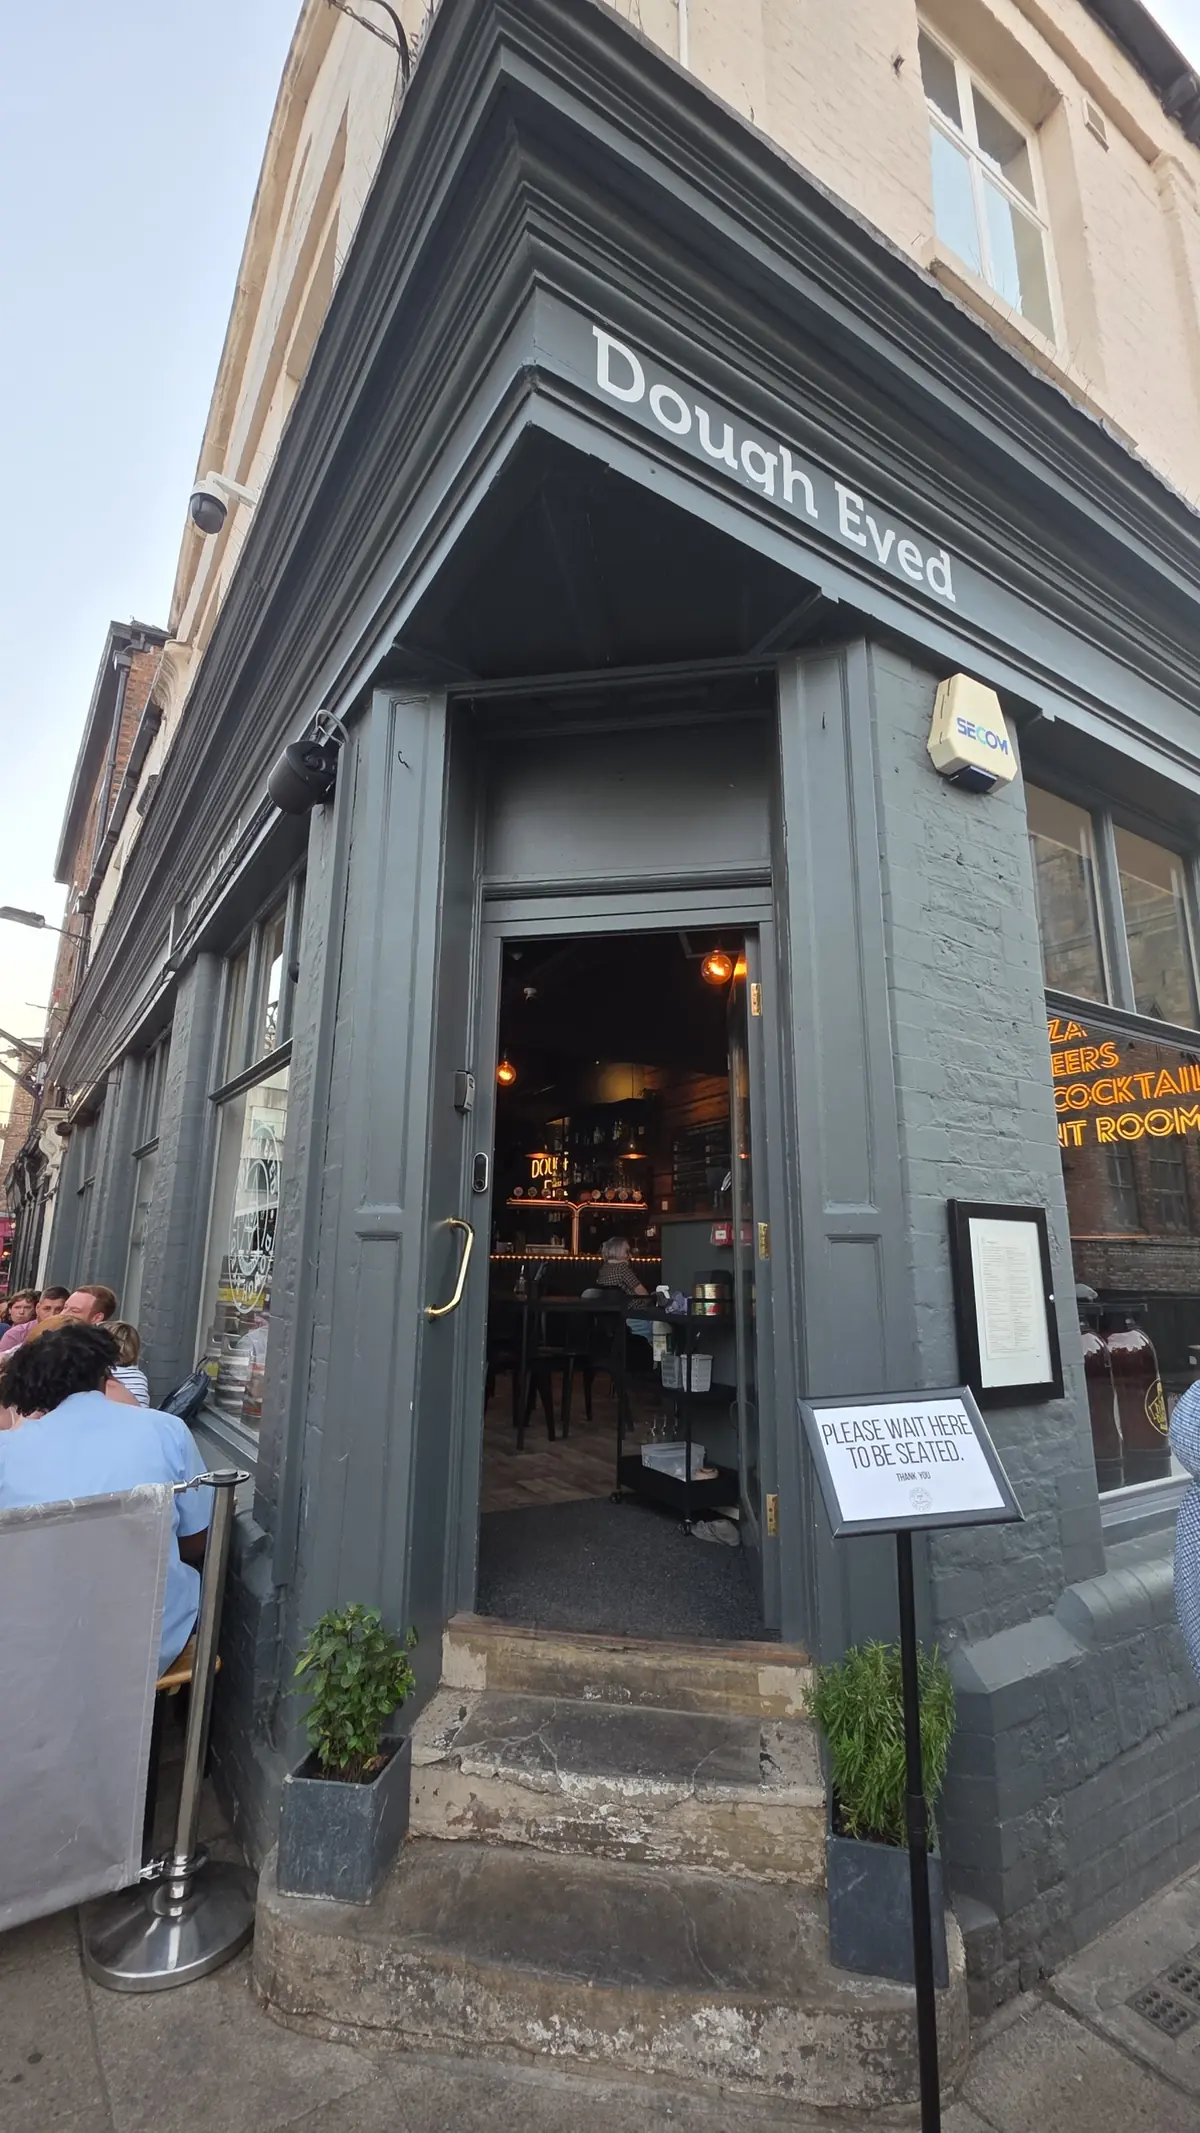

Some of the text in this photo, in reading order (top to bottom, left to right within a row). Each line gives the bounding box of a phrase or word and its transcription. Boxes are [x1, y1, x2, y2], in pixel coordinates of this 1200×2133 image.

[957, 717, 1009, 755] SECOM
[821, 1414, 973, 1446] PLEASE WAIT HERE
[846, 1440, 964, 1470] TO BE SEATED.
[896, 1471, 931, 1482] THANK YOU
